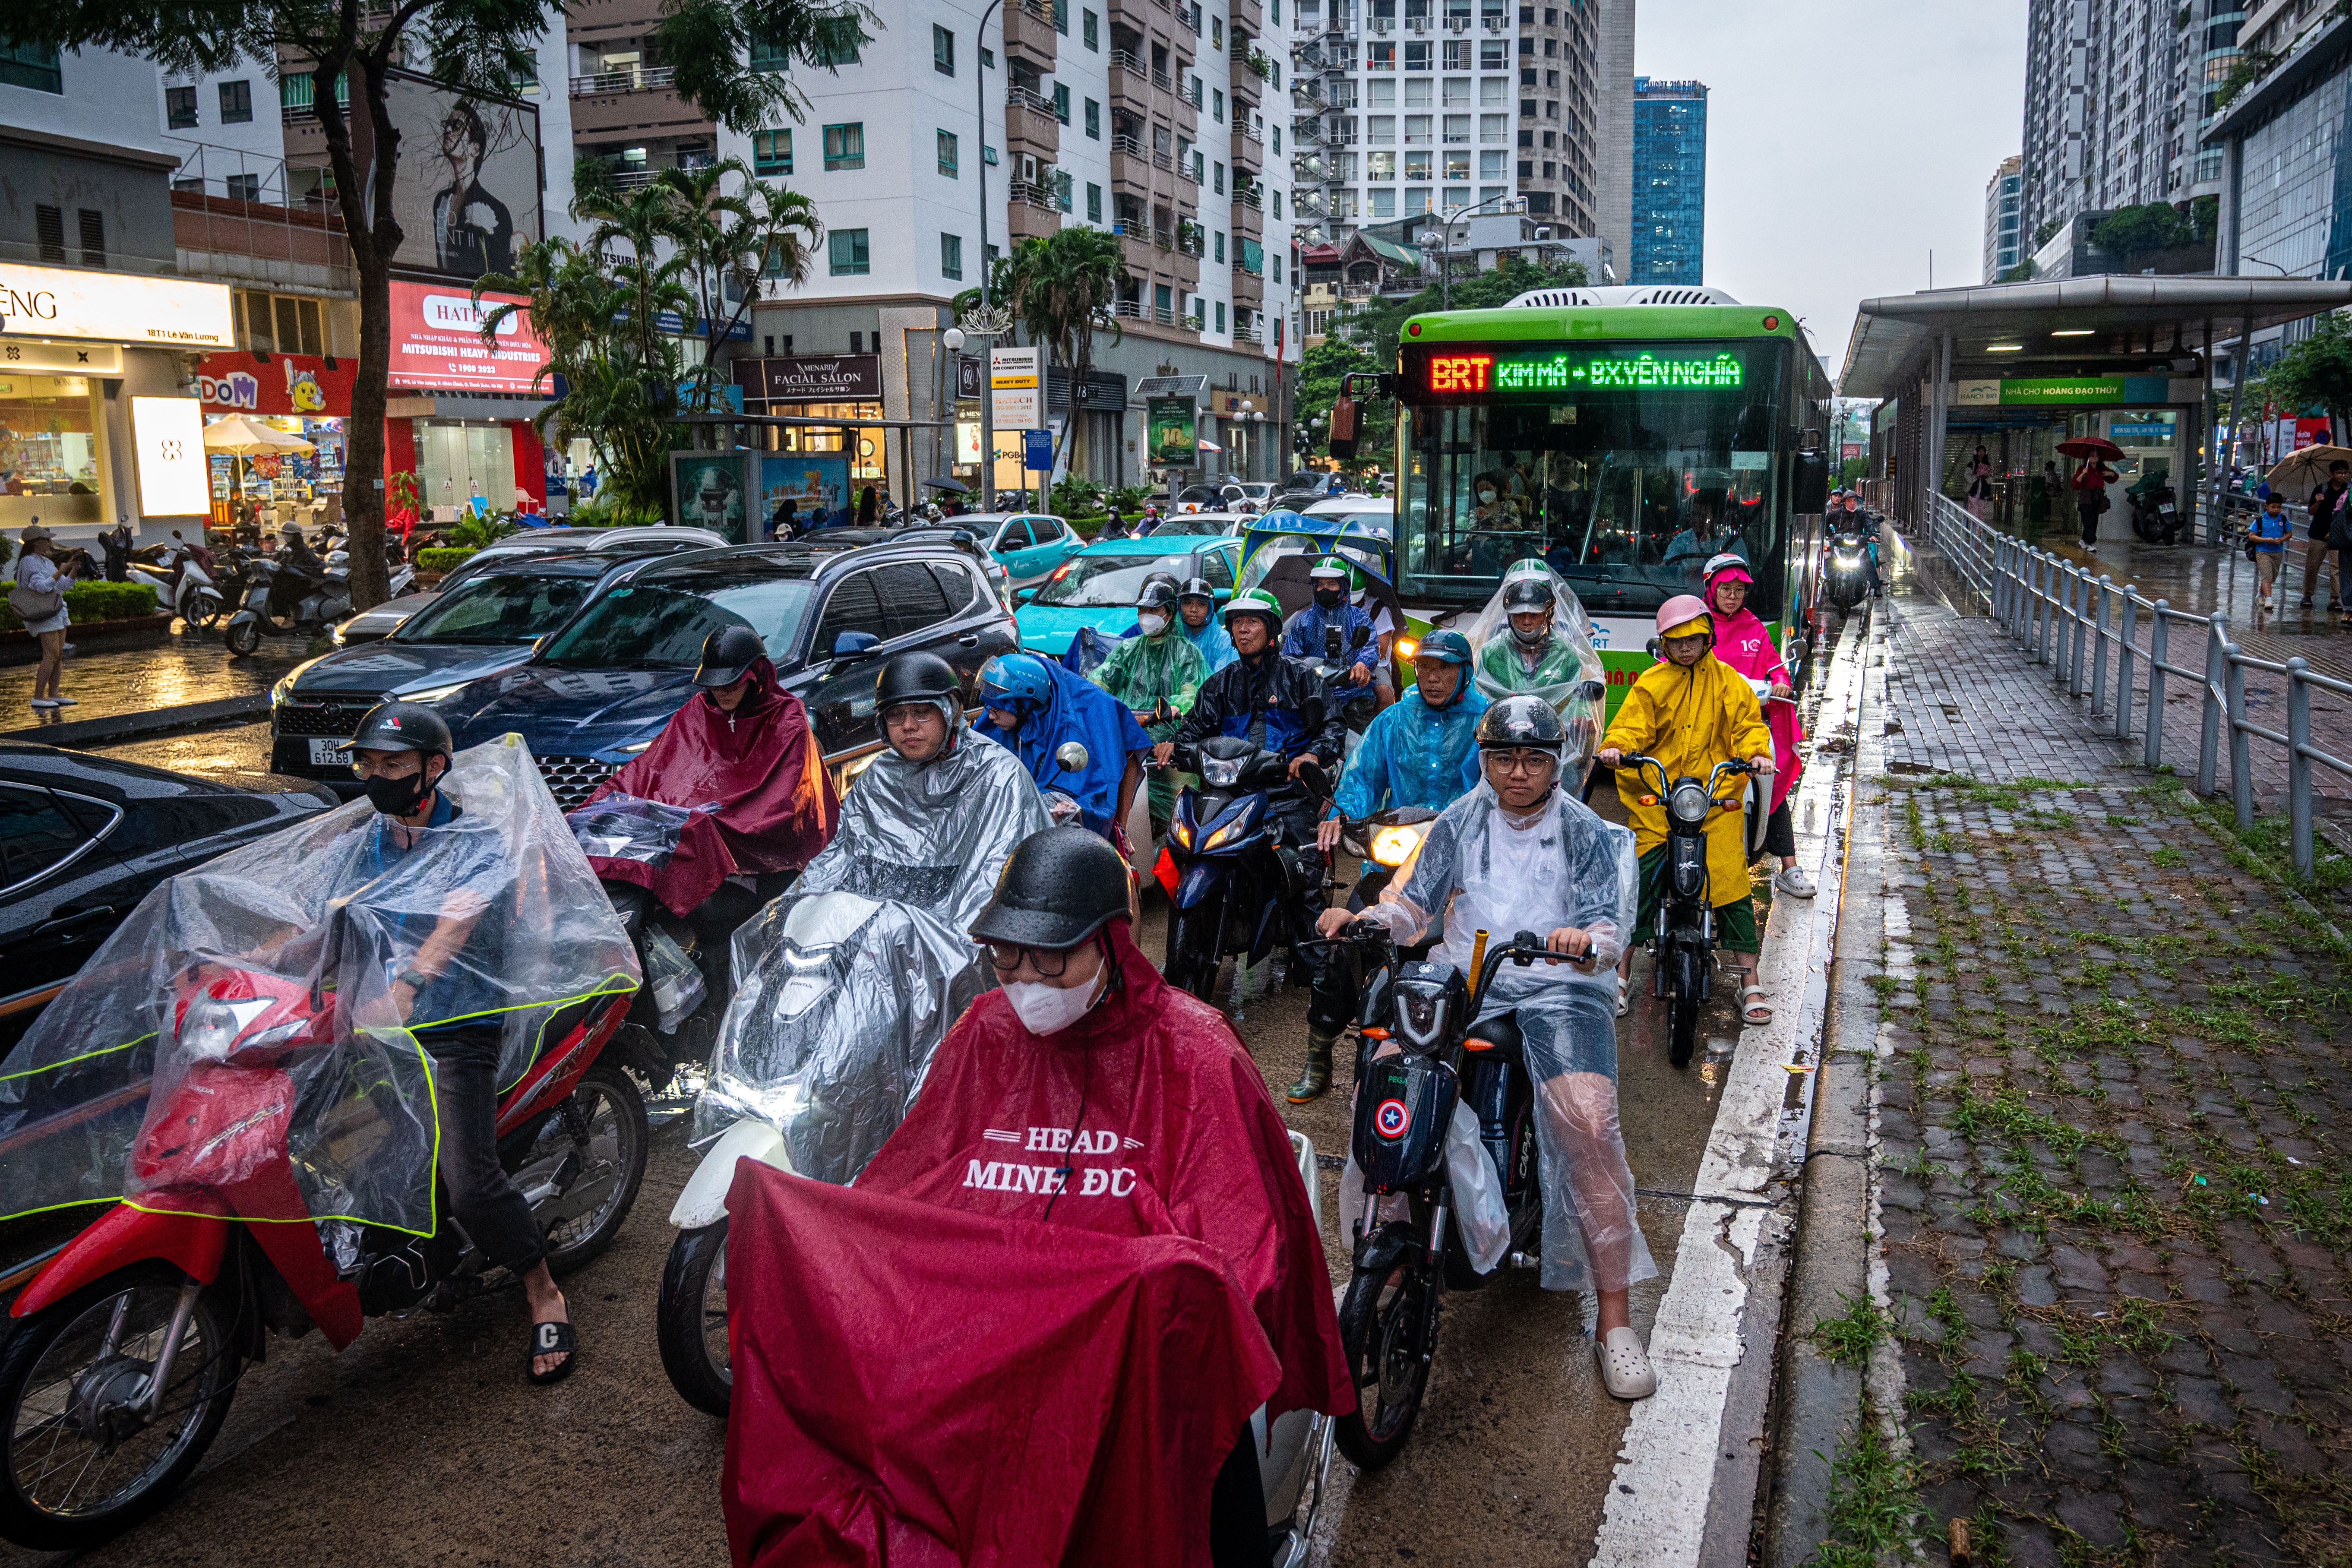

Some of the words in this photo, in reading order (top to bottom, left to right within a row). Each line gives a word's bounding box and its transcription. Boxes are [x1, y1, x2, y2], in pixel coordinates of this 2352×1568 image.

[147, 329, 165, 338] 18T1
[402, 343, 458, 357] MITSUBISHI
[460, 347, 489, 359] HEAVY
[491, 350, 541, 363] INDUSTRIES
[458, 363, 477, 373] 1900
[477, 365, 496, 374] 2023
[1432, 358, 1489, 389] BRT
[1498, 364, 1532, 386] KIM
[1536, 356, 1566, 386] MÃ
[775, 375, 817, 385] FACIAL
[821, 373, 861, 383] SALON
[2005, 386, 2022, 395] NHÀ
[2042, 386, 2074, 395] HOÀNG
[2074, 387, 2094, 396] ĐẠO
[2094, 386, 2118, 395] THÚY
[321, 740, 339, 751] 30H
[315, 752, 349, 764] 612.68
[790, 981, 812, 989] HONDA
[1388, 1075, 1407, 1084] PEGA
[1024, 1126, 1119, 1154] HEAD
[962, 1159, 1069, 1195] MINH
